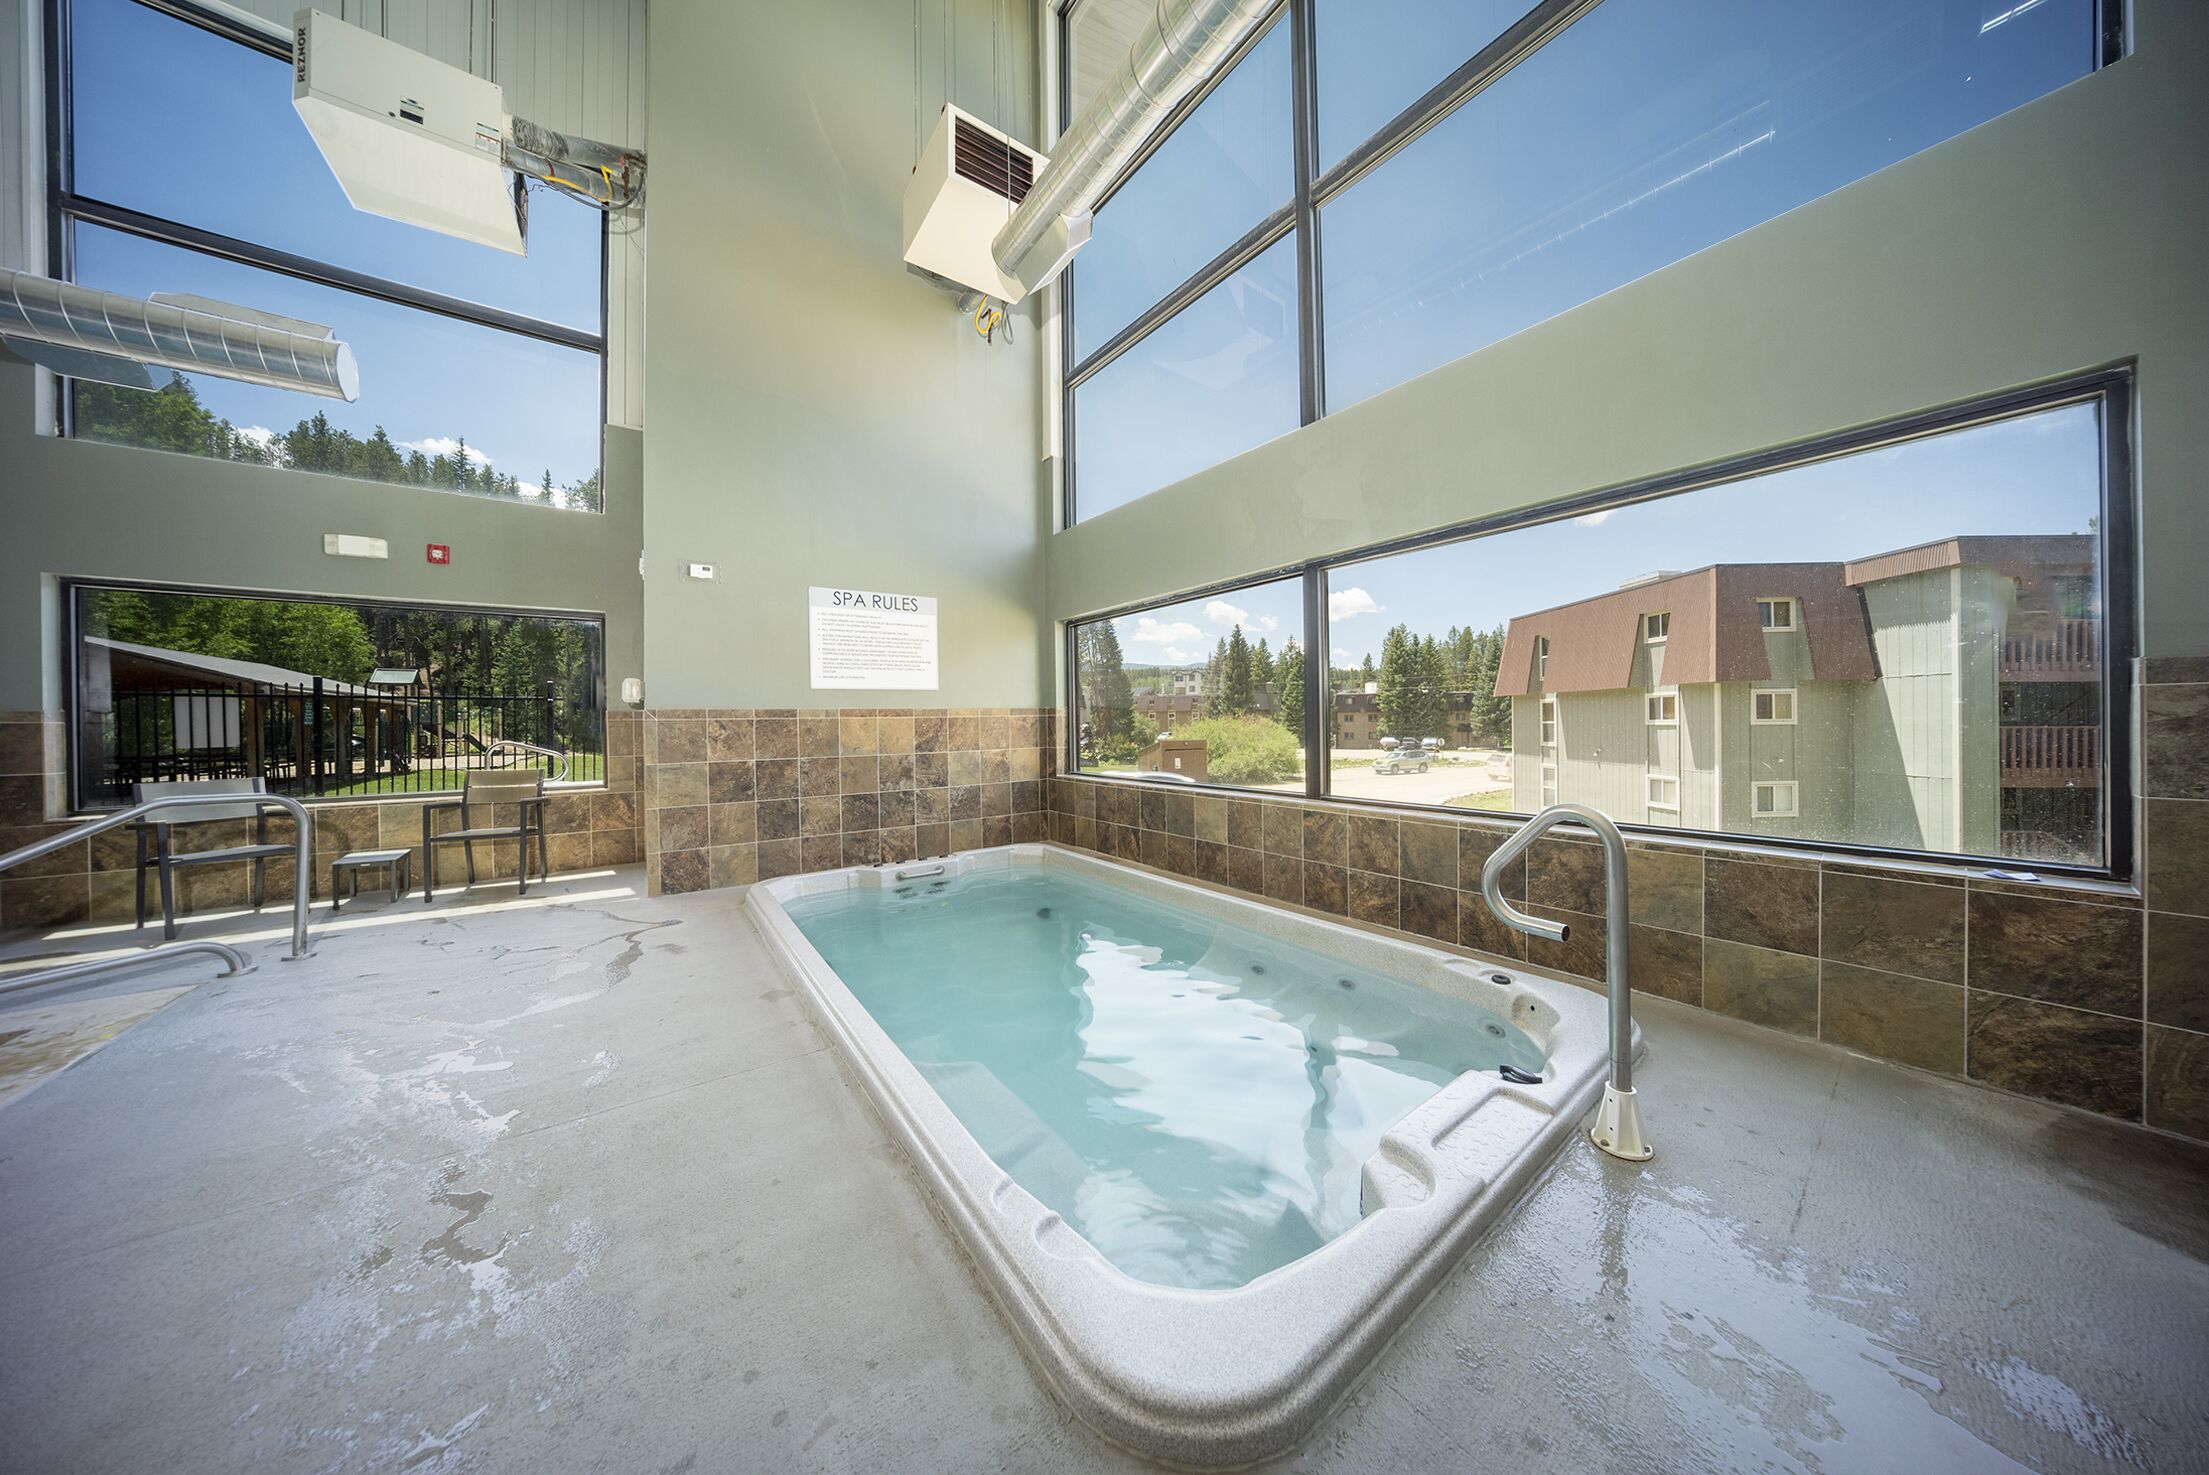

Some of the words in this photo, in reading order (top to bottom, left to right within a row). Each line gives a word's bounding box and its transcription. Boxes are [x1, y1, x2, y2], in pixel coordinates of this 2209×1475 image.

[297, 27, 306, 83] REZNOR
[833, 591, 866, 608] SPA
[873, 594, 918, 612] RULES
